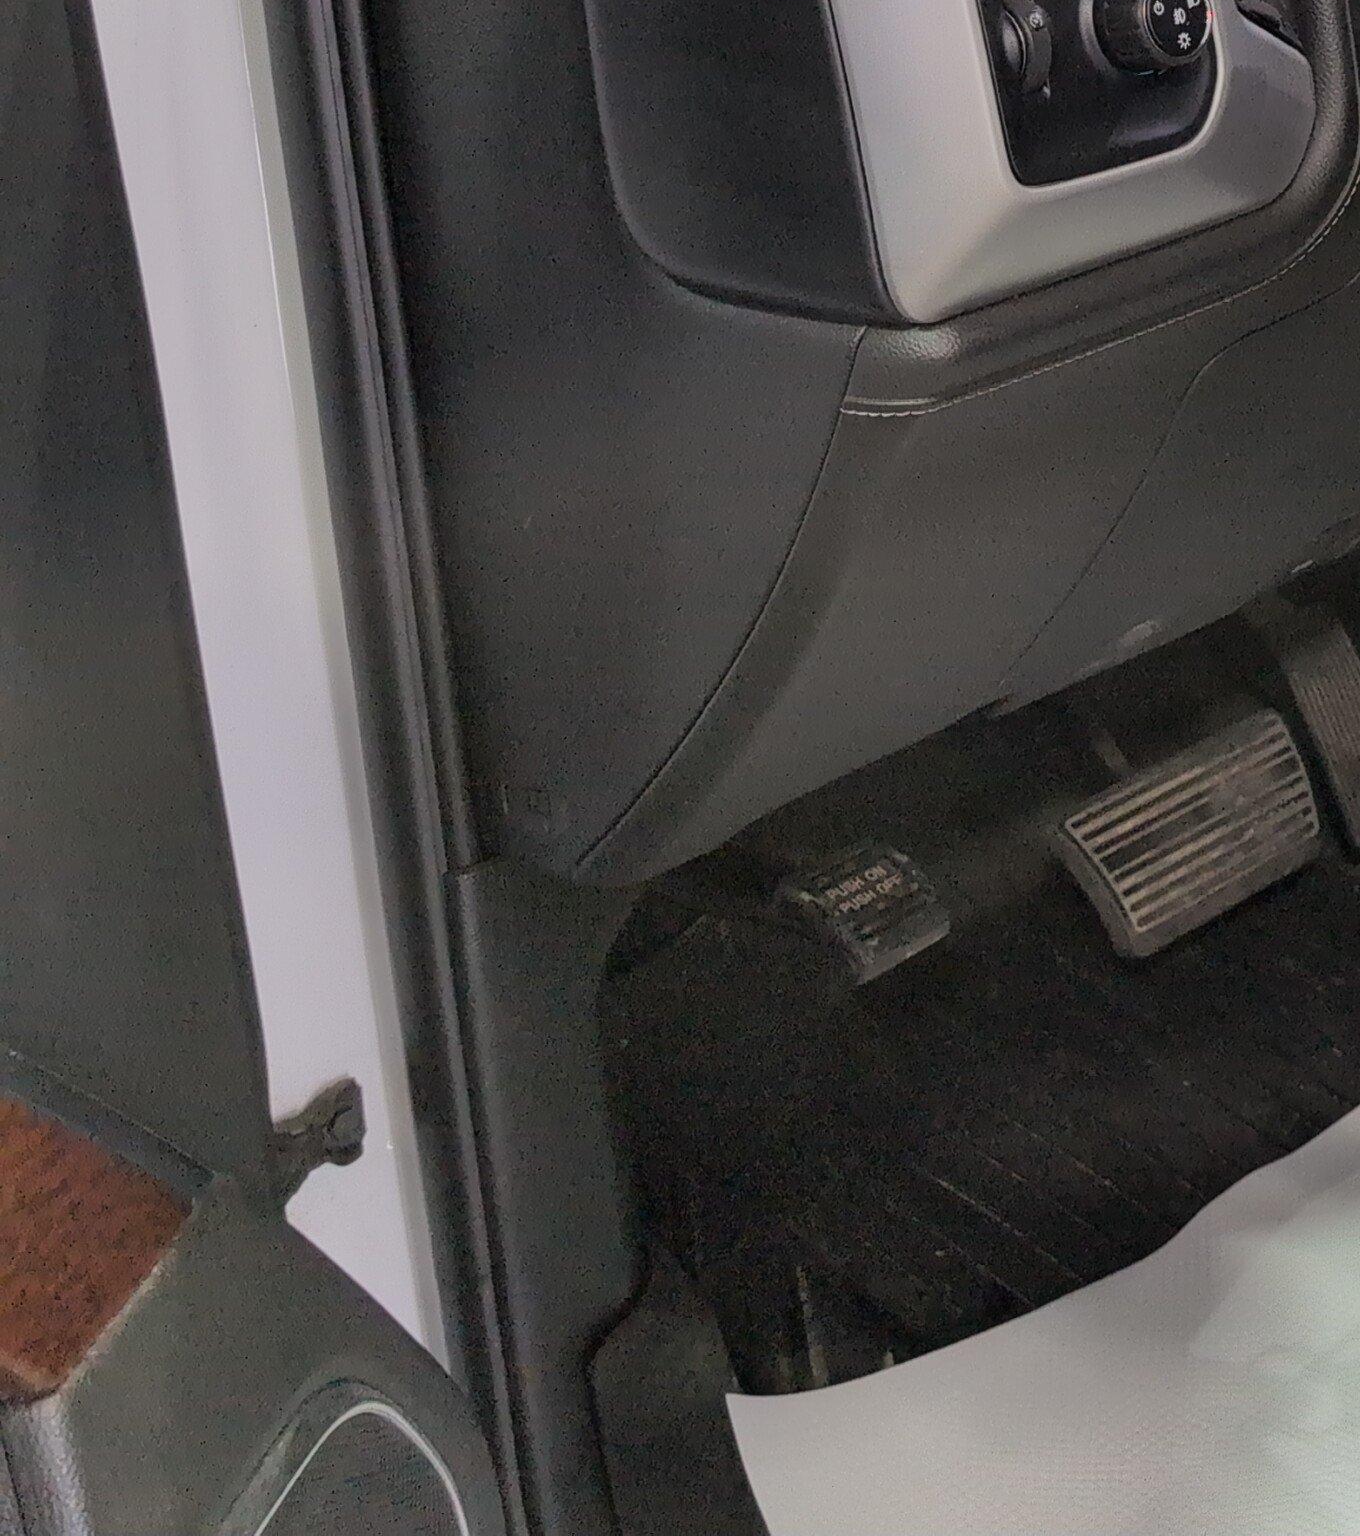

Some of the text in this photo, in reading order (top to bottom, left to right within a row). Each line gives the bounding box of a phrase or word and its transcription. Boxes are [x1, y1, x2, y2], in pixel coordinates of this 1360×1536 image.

[825, 865, 887, 900] PUSH ON
[839, 889, 876, 913] PUSH
